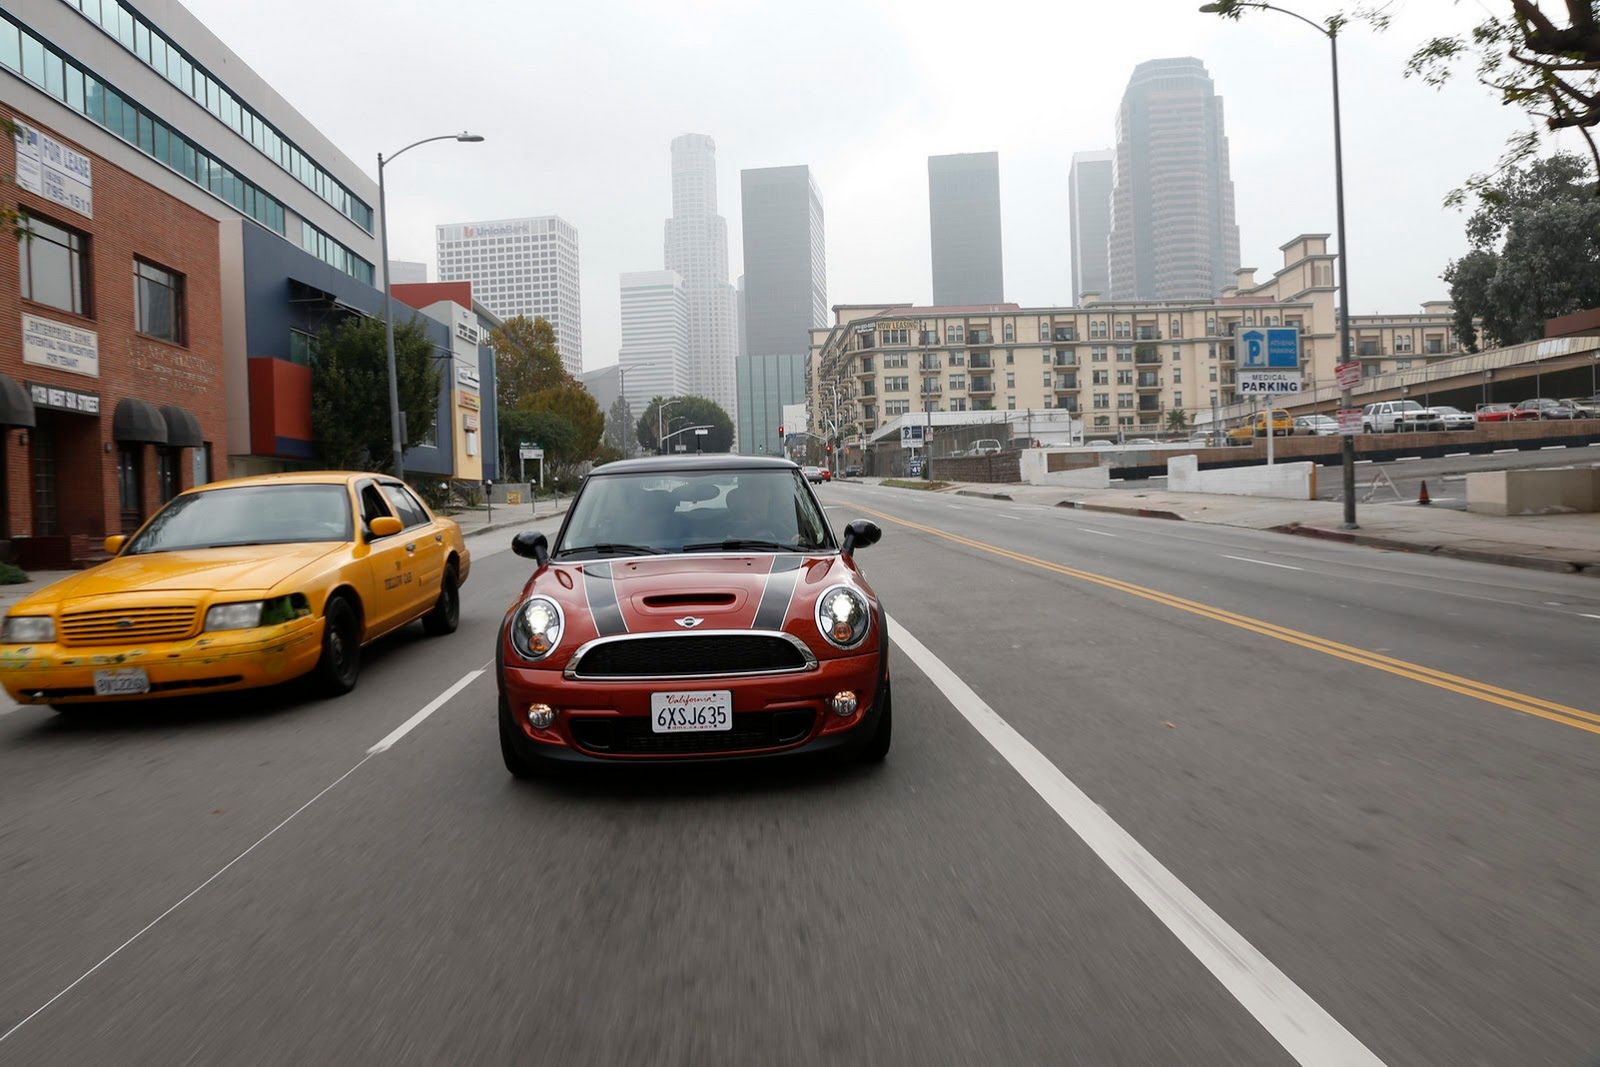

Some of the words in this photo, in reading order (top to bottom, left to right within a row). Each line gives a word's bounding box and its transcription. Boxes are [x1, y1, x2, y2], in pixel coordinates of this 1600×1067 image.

[43, 137, 61, 166] FOR
[63, 147, 89, 179] LEASE
[30, 320, 72, 341] ENTERPRISE
[877, 321, 891, 330] NOW
[1242, 382, 1298, 392] PARKING
[667, 693, 714, 706] California
[657, 706, 727, 727] 6XSJ635
